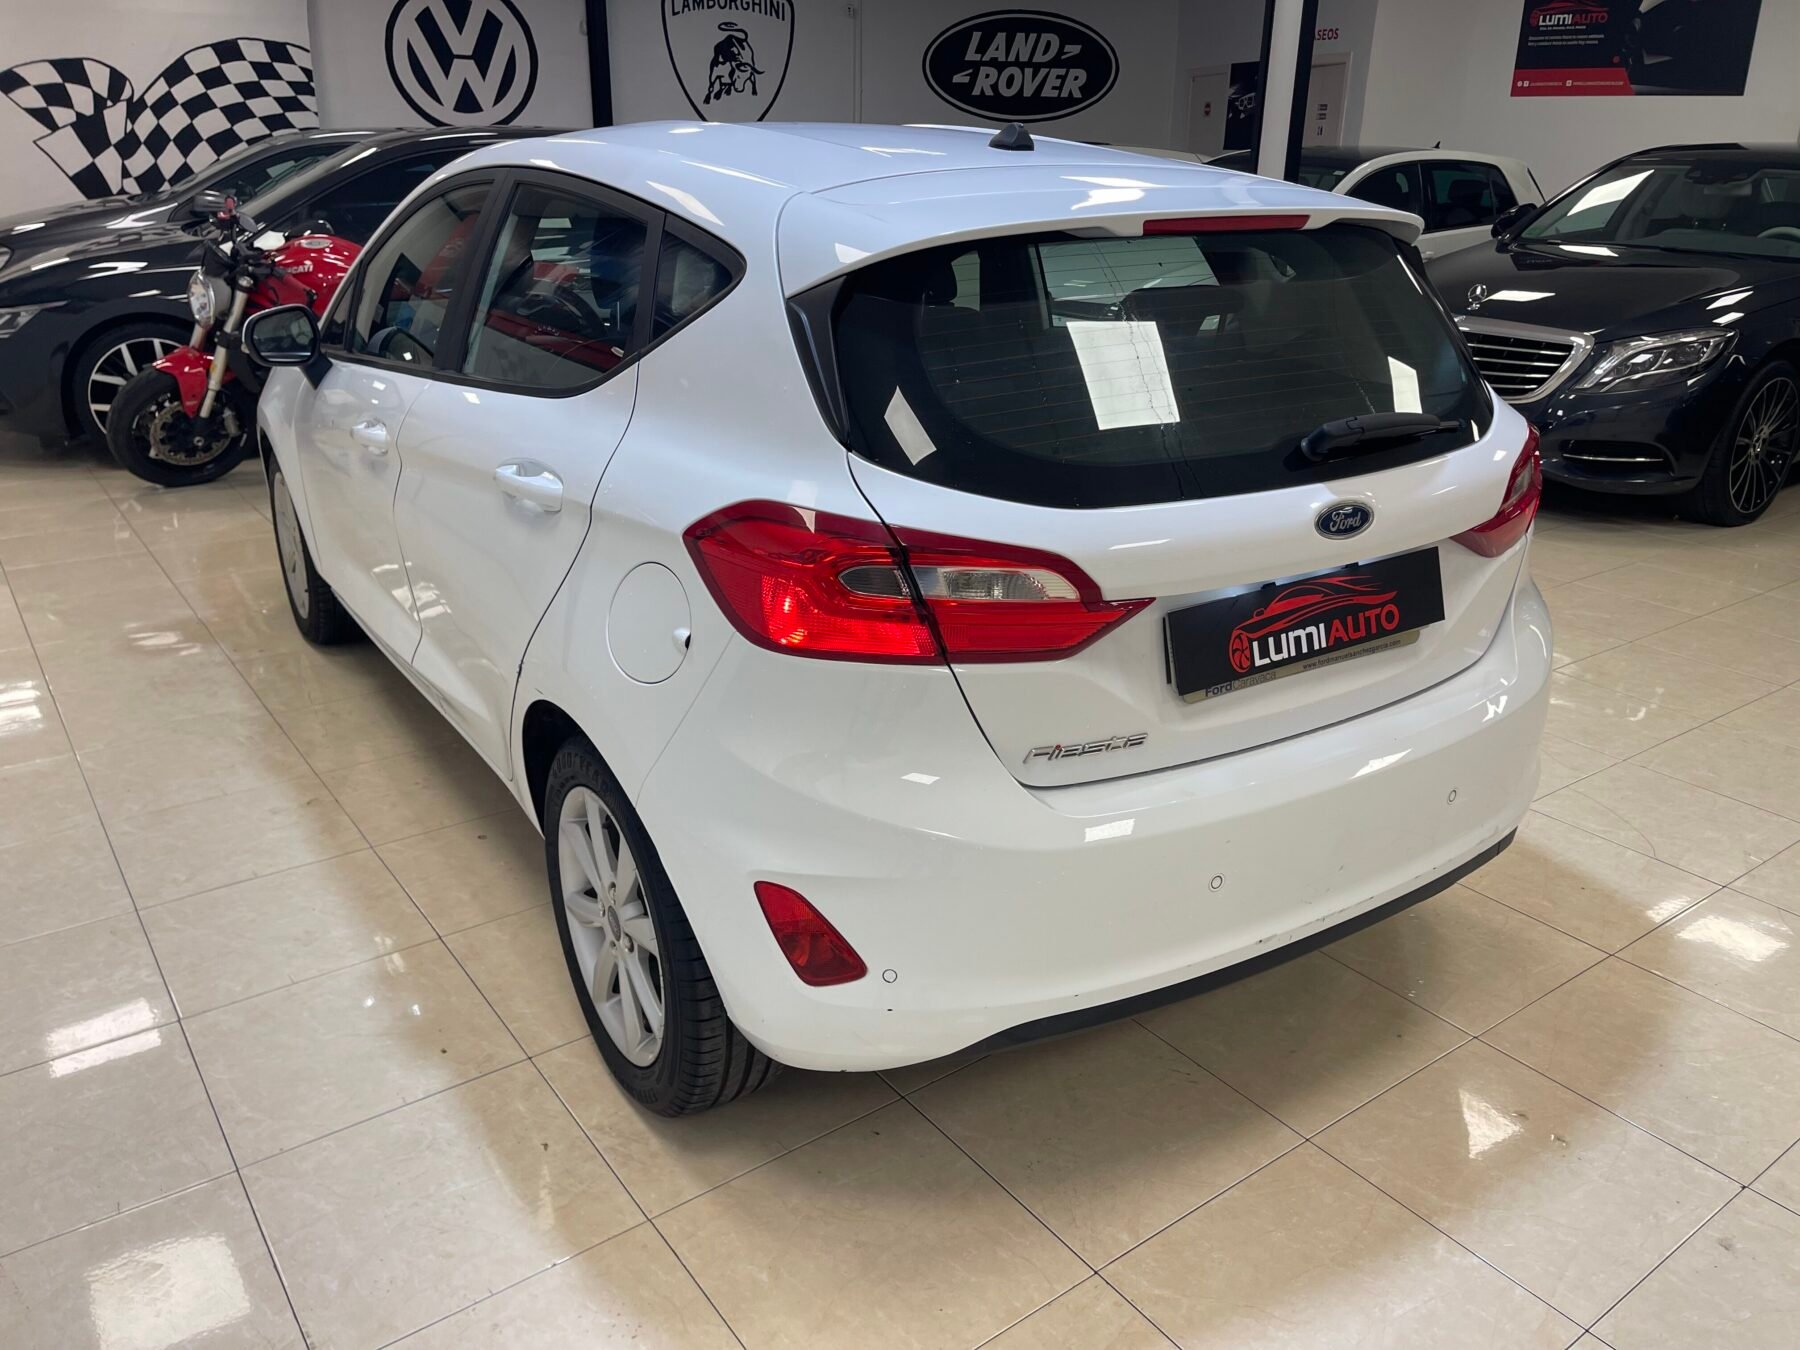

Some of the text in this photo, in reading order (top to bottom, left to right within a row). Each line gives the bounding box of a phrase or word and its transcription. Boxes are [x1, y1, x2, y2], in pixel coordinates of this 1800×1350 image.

[964, 31, 1060, 63] LAND
[1313, 28, 1340, 41] SEOS
[971, 66, 1088, 98] ROVER
